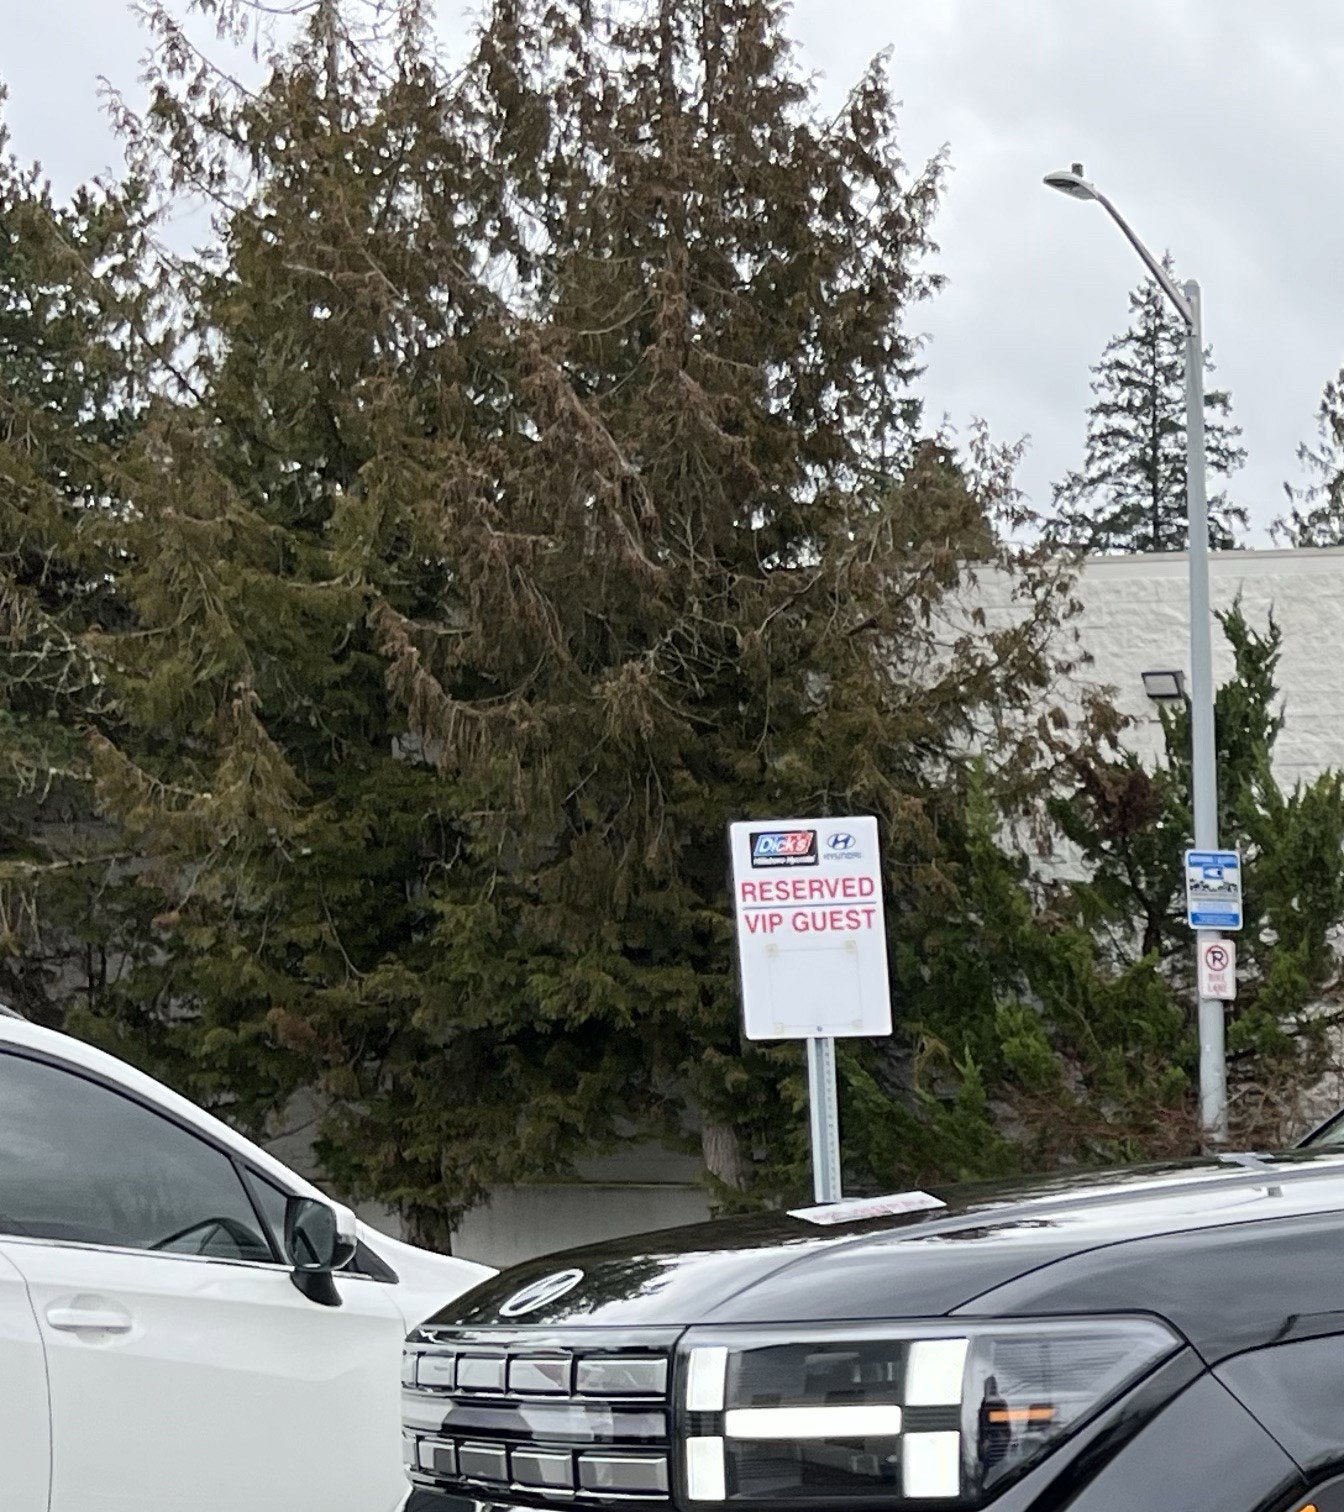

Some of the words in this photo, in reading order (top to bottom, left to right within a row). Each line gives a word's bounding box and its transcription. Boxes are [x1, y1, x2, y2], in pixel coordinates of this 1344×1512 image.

[741, 877, 875, 902] RESERVED
[744, 913, 783, 934] VIP
[791, 908, 876, 932] GUEST
